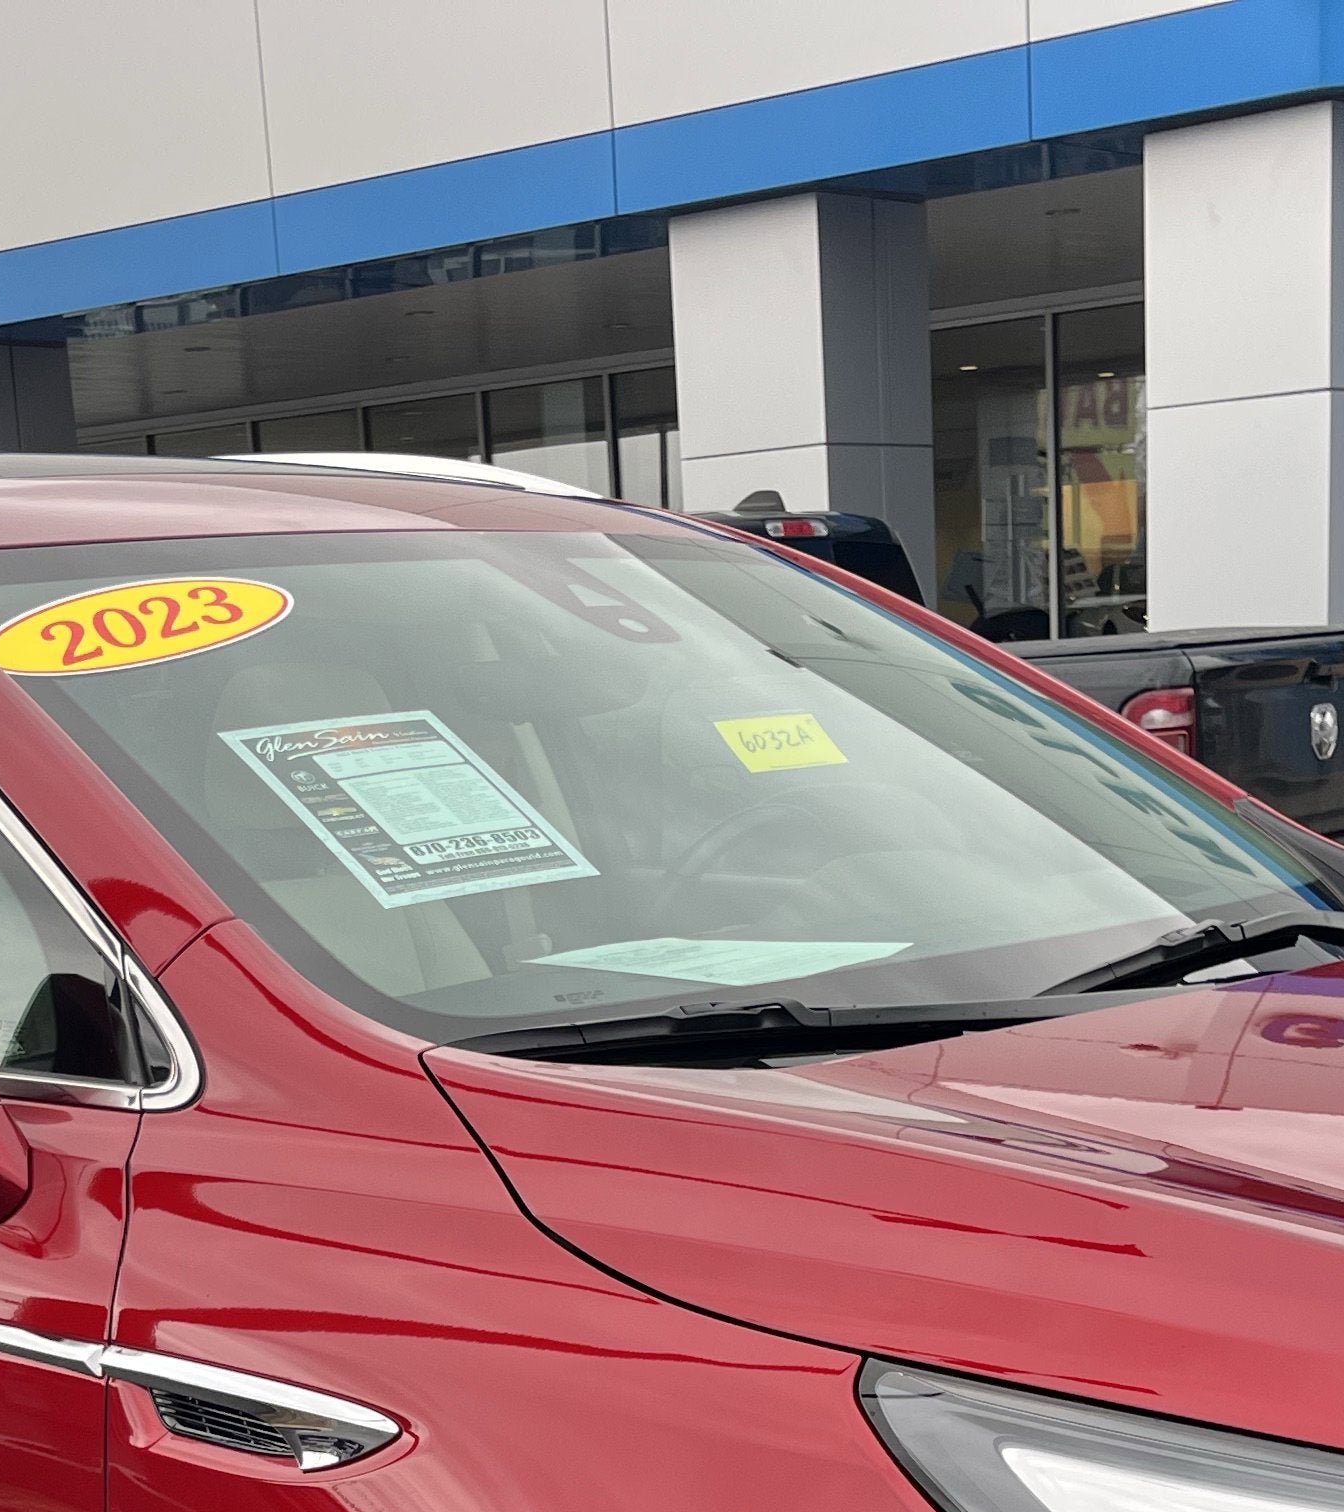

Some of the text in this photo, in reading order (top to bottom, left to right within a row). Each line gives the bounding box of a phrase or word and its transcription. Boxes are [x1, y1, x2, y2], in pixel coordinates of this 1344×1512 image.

[40, 586, 244, 666] 2023
[256, 735, 320, 761] Glen
[314, 729, 390, 750] Sain
[738, 725, 815, 753] 6032A
[296, 783, 329, 793] BUICK
[409, 828, 542, 857] 870-236-8503
